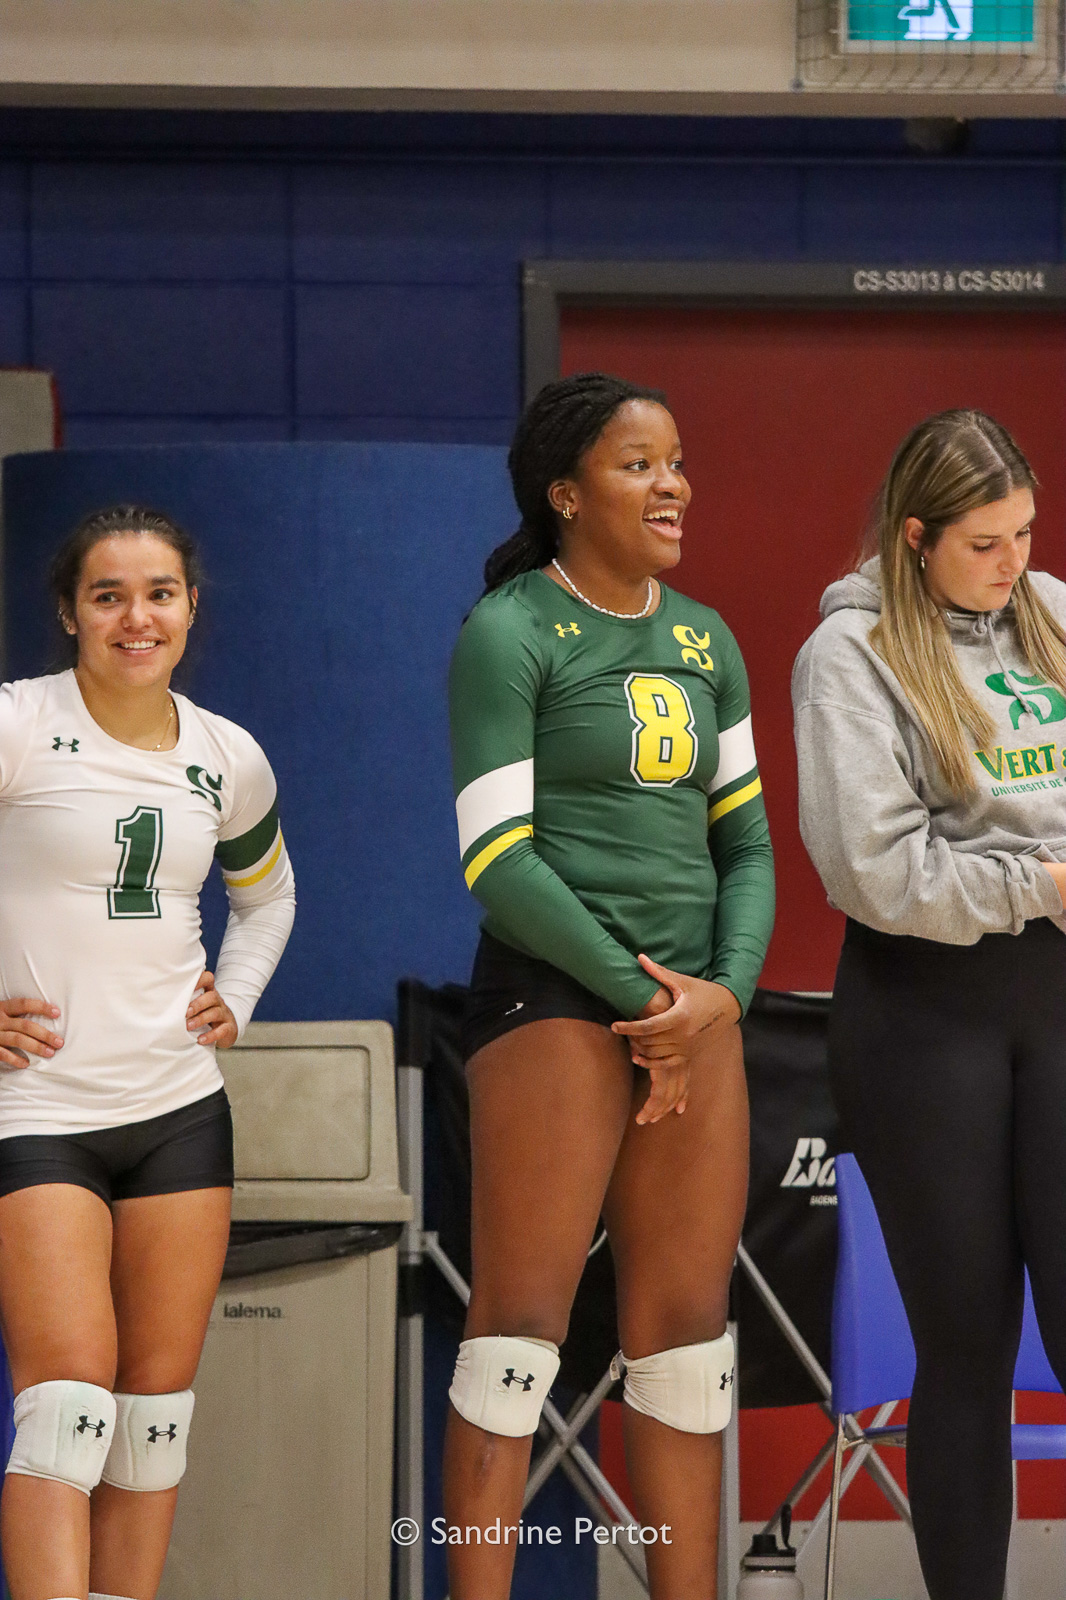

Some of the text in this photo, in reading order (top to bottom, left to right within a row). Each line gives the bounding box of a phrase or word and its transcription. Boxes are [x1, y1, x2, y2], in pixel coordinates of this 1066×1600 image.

[853, 270, 939, 291] CS-S3013
[958, 270, 1045, 291] CS-S3014
[624, 672, 698, 787] 8
[973, 742, 1057, 782] VERT
[991, 779, 1048, 797] UNIVERSITÉ
[1048, 778, 1063, 788] DE
[107, 805, 163, 919] 1
